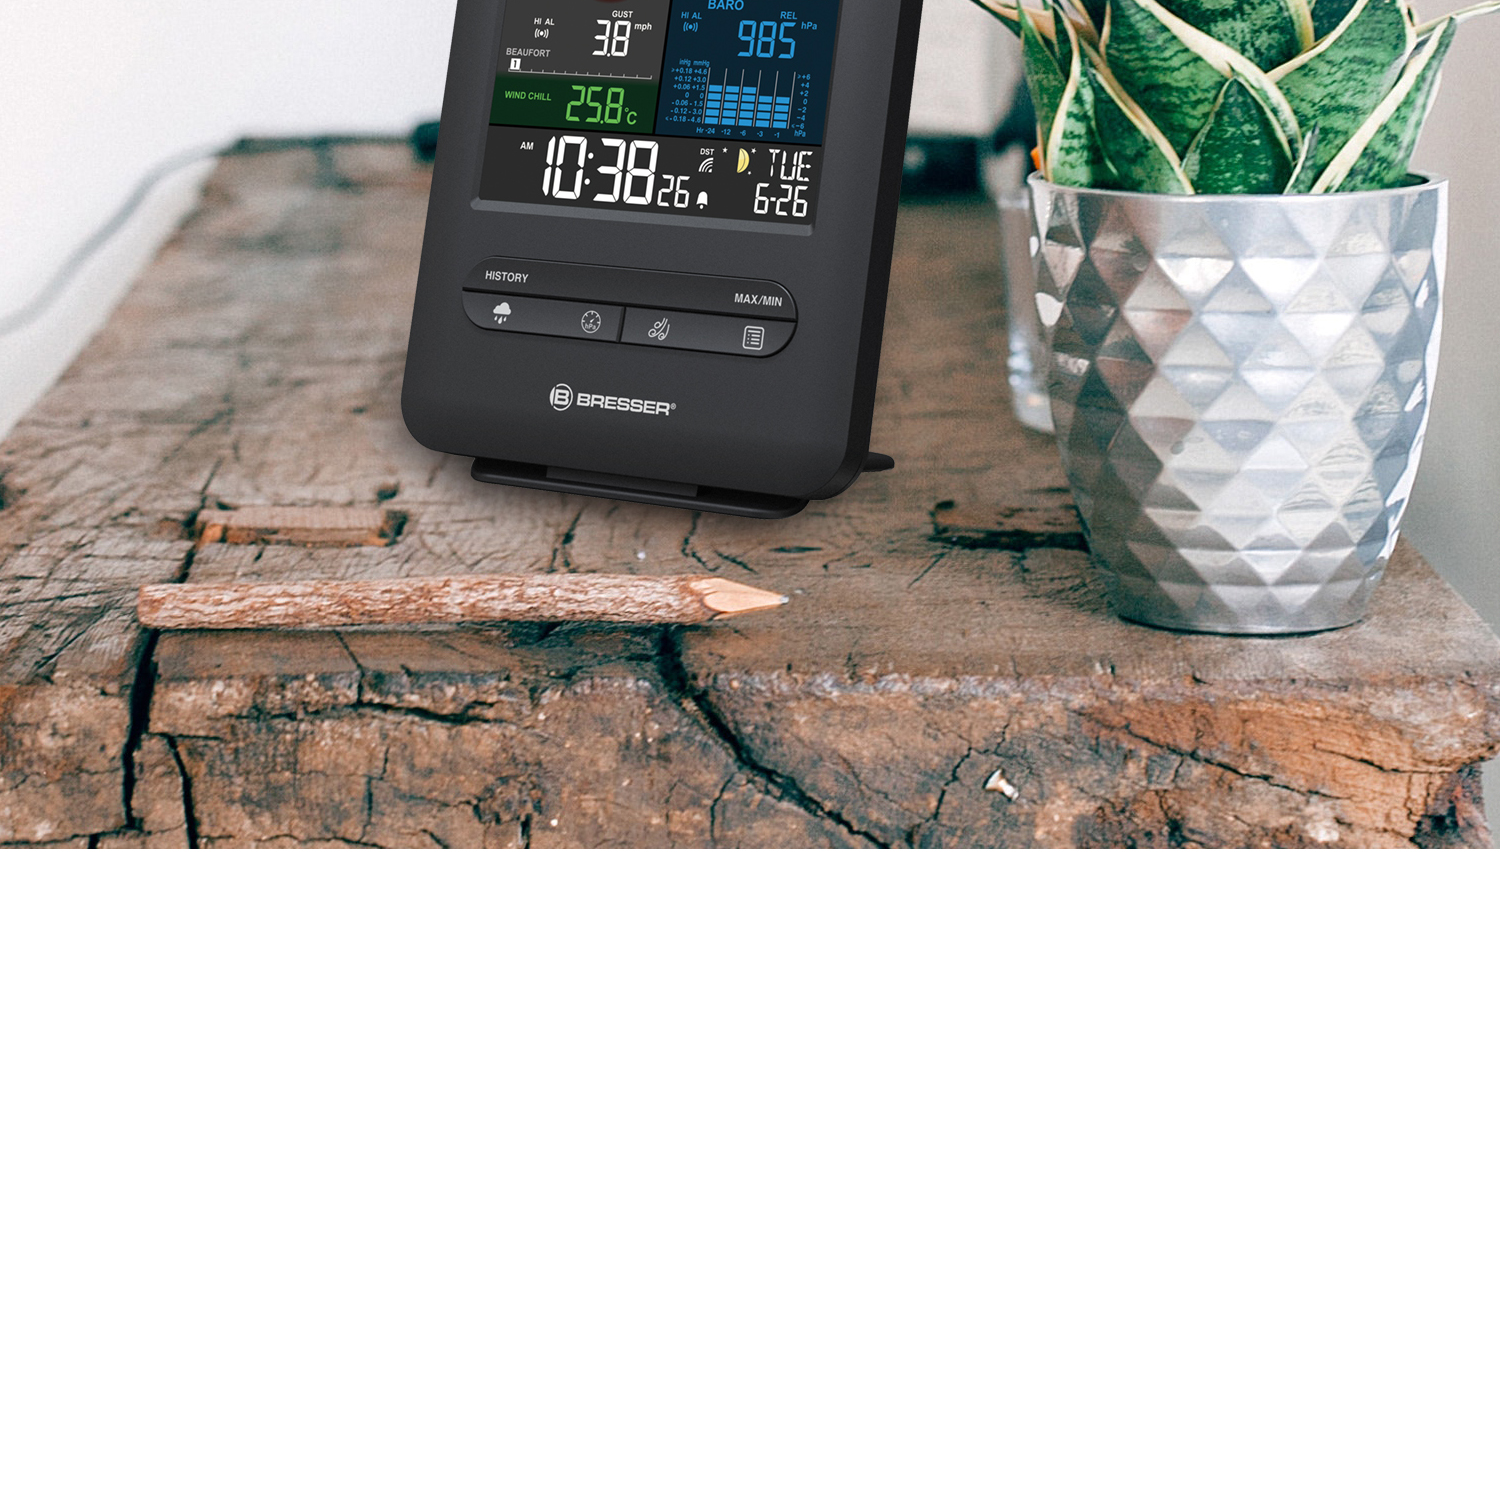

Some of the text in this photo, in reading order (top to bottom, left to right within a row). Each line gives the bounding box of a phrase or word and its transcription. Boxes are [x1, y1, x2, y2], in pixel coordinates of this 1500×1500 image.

[611, 10, 633, 18] GUST
[681, 11, 689, 19] HI
[780, 11, 798, 20] REL
[533, 17, 555, 26] HI AL
[592, 19, 652, 57] 3.8 mph
[737, 20, 818, 59] 985 hPa
[505, 47, 551, 58] BEAUFORT
[692, 59, 711, 68] mmHg
[504, 90, 552, 101] WIND CHILL
[696, 126, 704, 134] Hr
[721, 128, 732, 136] -12
[740, 129, 747, 137] -6
[757, 130, 764, 138] -3
[793, 129, 807, 138] hPa
[520, 141, 534, 150] AM
[700, 148, 715, 156] DST
[768, 148, 814, 182] TUE
[542, 135, 691, 208] 10:38 26
[753, 182, 809, 218] 6-26
[485, 270, 529, 284] HISTORY
[734, 293, 783, 307] MAX/MIN
[584, 322, 597, 331] hPa
